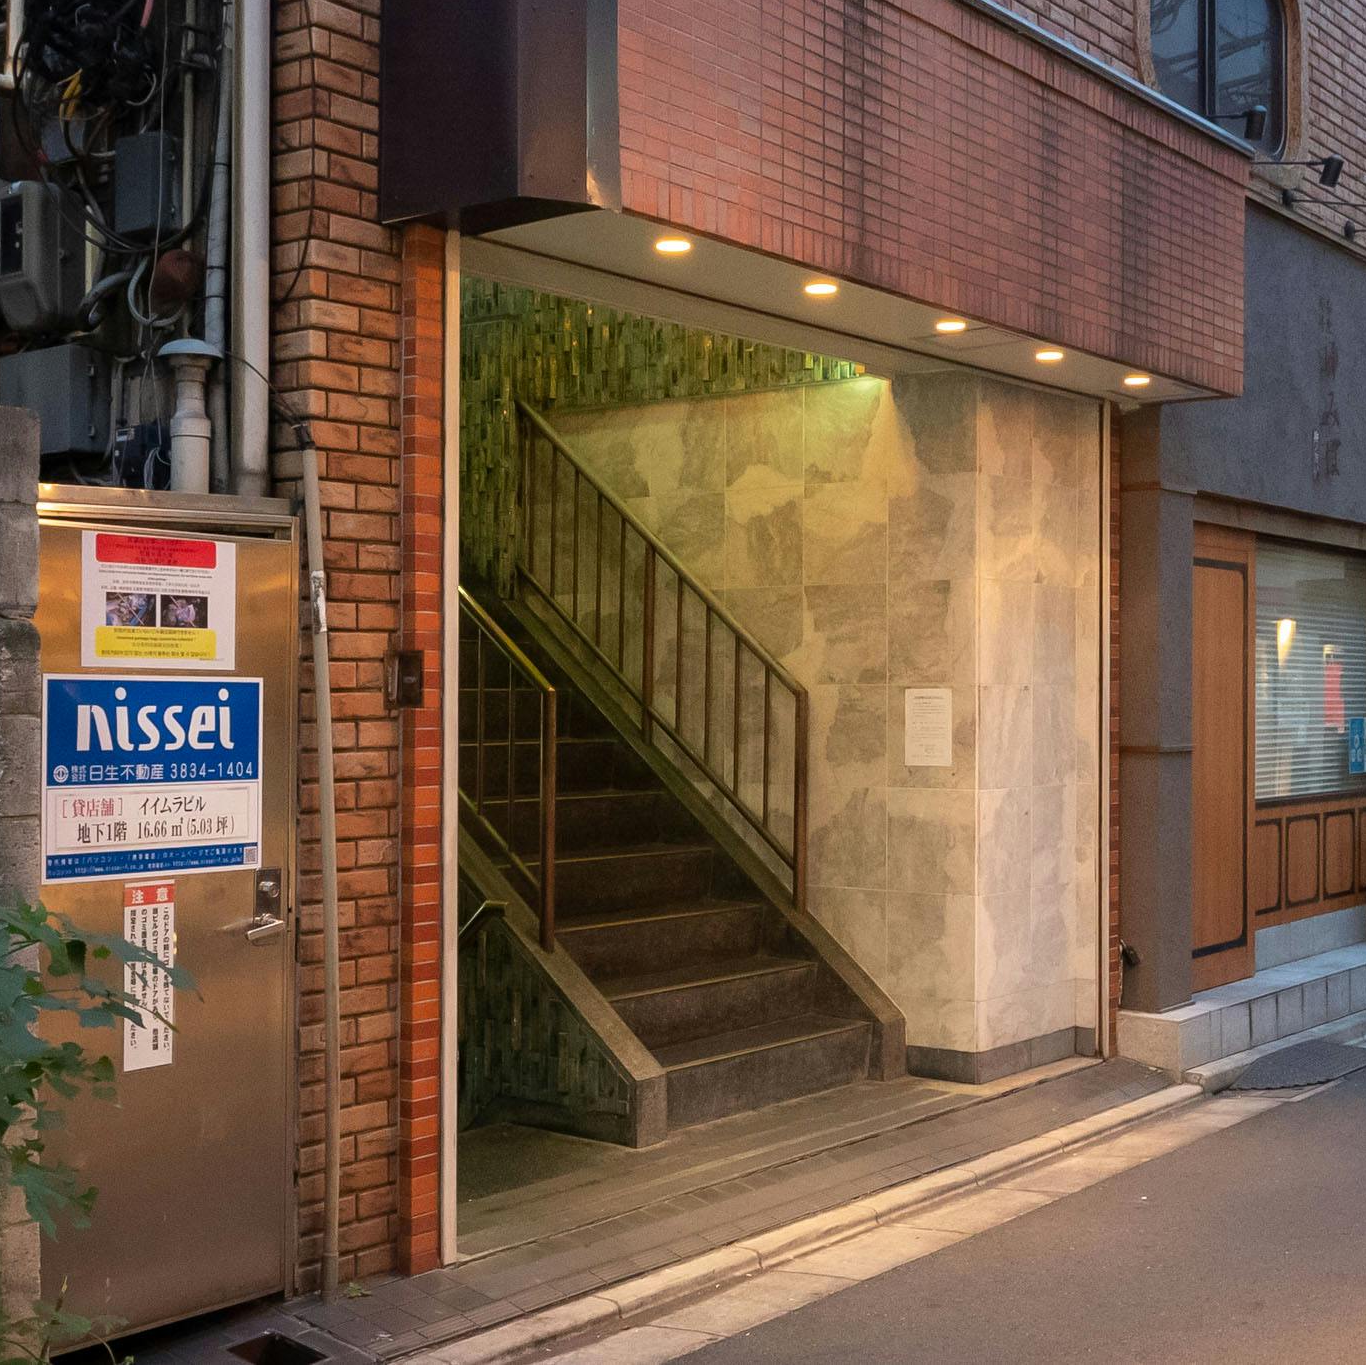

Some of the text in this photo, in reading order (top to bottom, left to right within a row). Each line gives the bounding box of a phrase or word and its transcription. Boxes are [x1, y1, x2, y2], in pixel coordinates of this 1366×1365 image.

[76, 687, 235, 752] nissei
[89, 764, 164, 782] 日生不動産
[170, 761, 253, 780] 3834-1404
[139, 795, 207, 816] イイムラビル
[77, 821, 128, 844] 地下1階
[137, 821, 168, 840] 16.66
[131, 887, 169, 904] 注意
